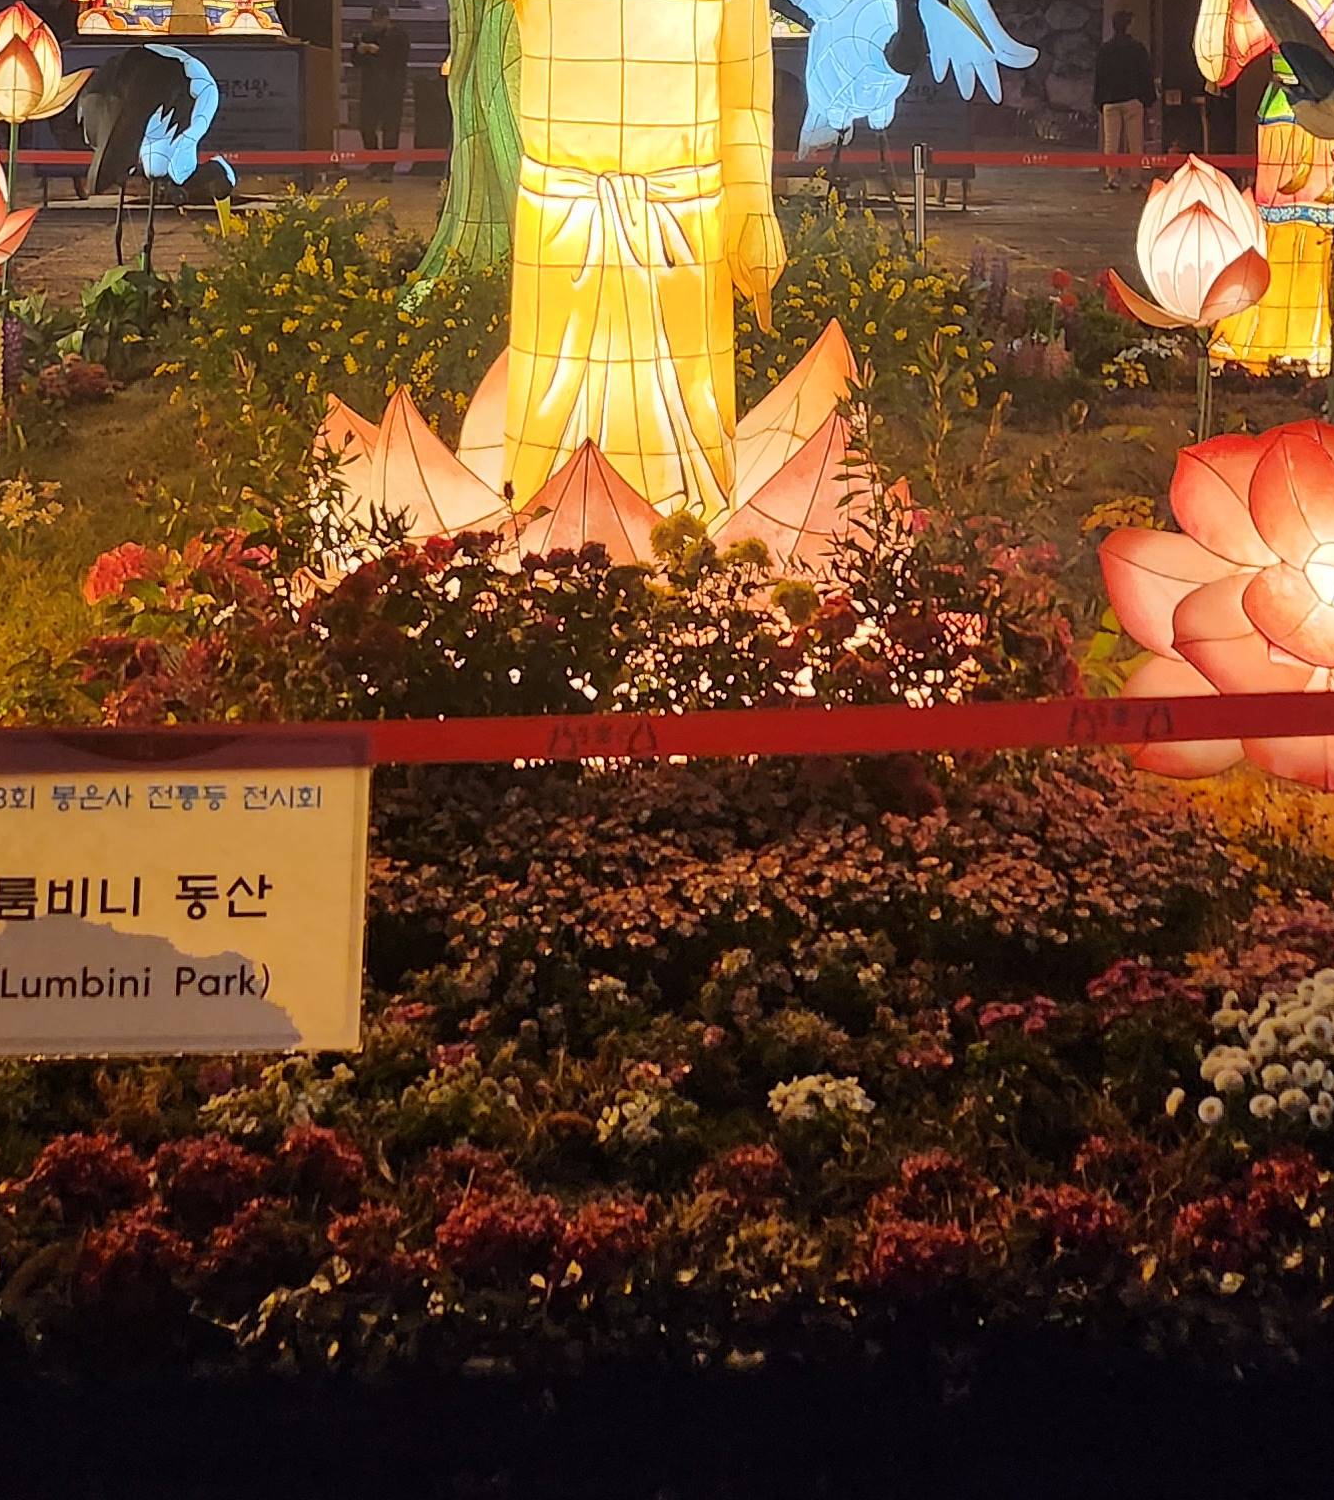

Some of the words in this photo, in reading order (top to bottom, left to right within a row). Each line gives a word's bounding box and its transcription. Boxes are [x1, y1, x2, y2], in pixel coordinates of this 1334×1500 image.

[50, 784, 134, 812] 봉은사
[242, 784, 323, 811] 전시회
[174, 873, 274, 921] 동산
[174, 963, 271, 1000] Park)
